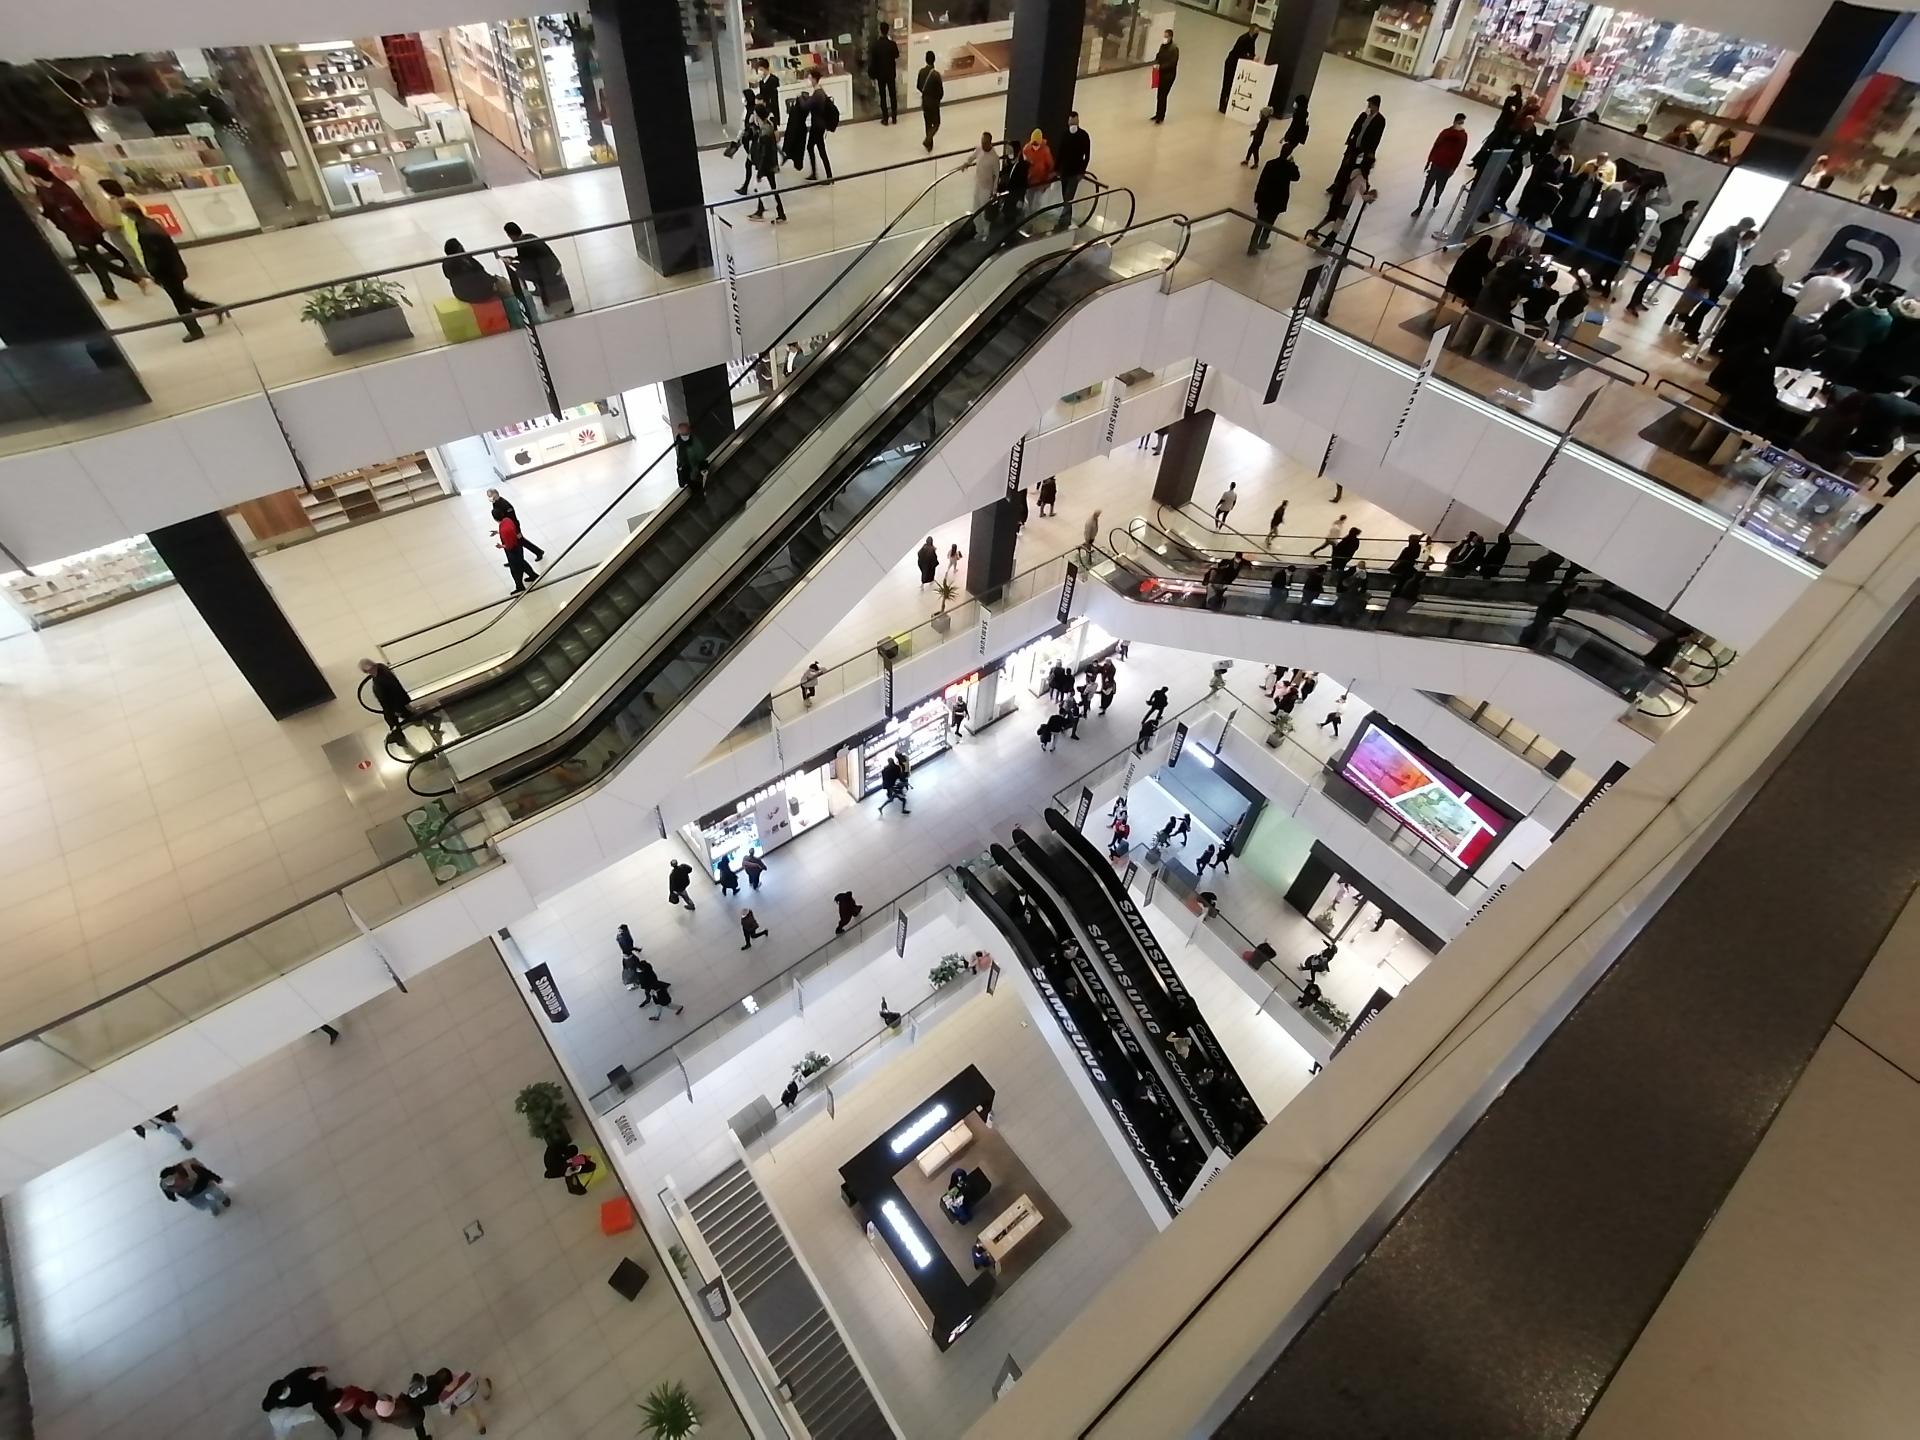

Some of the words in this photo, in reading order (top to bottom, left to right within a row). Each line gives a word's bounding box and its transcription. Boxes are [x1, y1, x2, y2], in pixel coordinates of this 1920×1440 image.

[1275, 295, 1311, 381] SAMSUNG
[1106, 395, 1121, 443] SAMSUNG
[1060, 574, 1074, 614] SAMSUNG
[535, 975, 562, 1015] SAMSUNG
[1074, 957, 1139, 1053] AMSUNG
[1087, 923, 1161, 1034] SAMSUNG
[1032, 966, 1107, 1082] SAMSUNG
[1165, 1049, 1203, 1105] Galaxy
[614, 1115, 638, 1146] SAMSUNG
[1111, 1098, 1150, 1157] Galaxy
